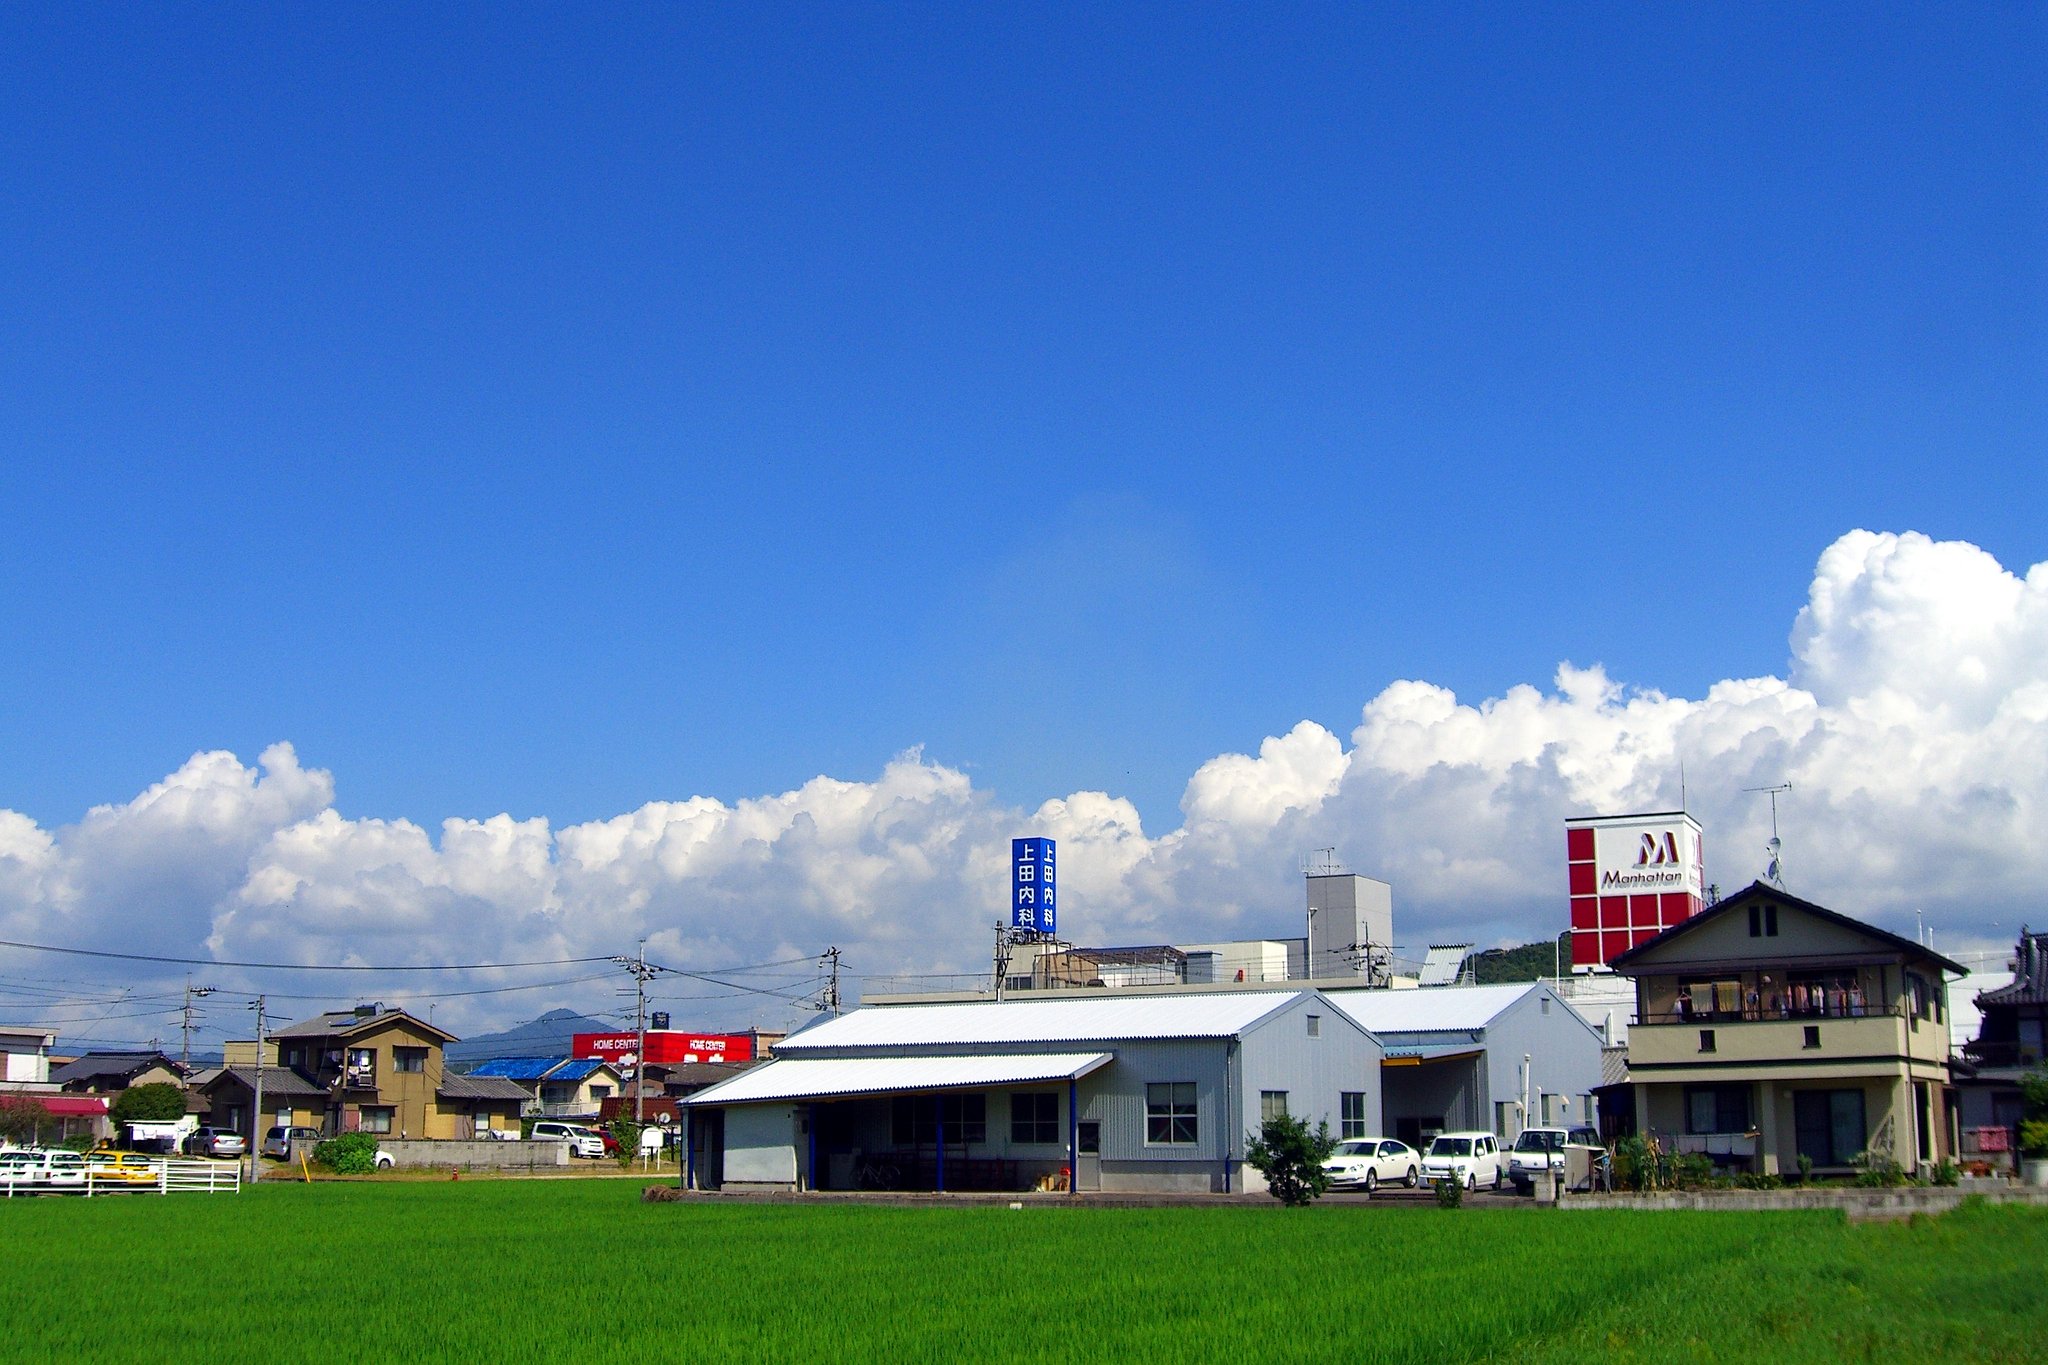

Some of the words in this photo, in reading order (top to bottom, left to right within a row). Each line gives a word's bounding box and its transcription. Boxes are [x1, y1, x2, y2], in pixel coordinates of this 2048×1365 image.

[1018, 843, 1035, 925] 上田内科
[1043, 844, 1053, 926] 上田内科
[1602, 870, 1682, 885] Manhattan
[593, 1039, 614, 1050] HOME
[614, 1039, 639, 1050] CENTE
[689, 1039, 706, 1051] HOME
[705, 1040, 726, 1052] CENTER
